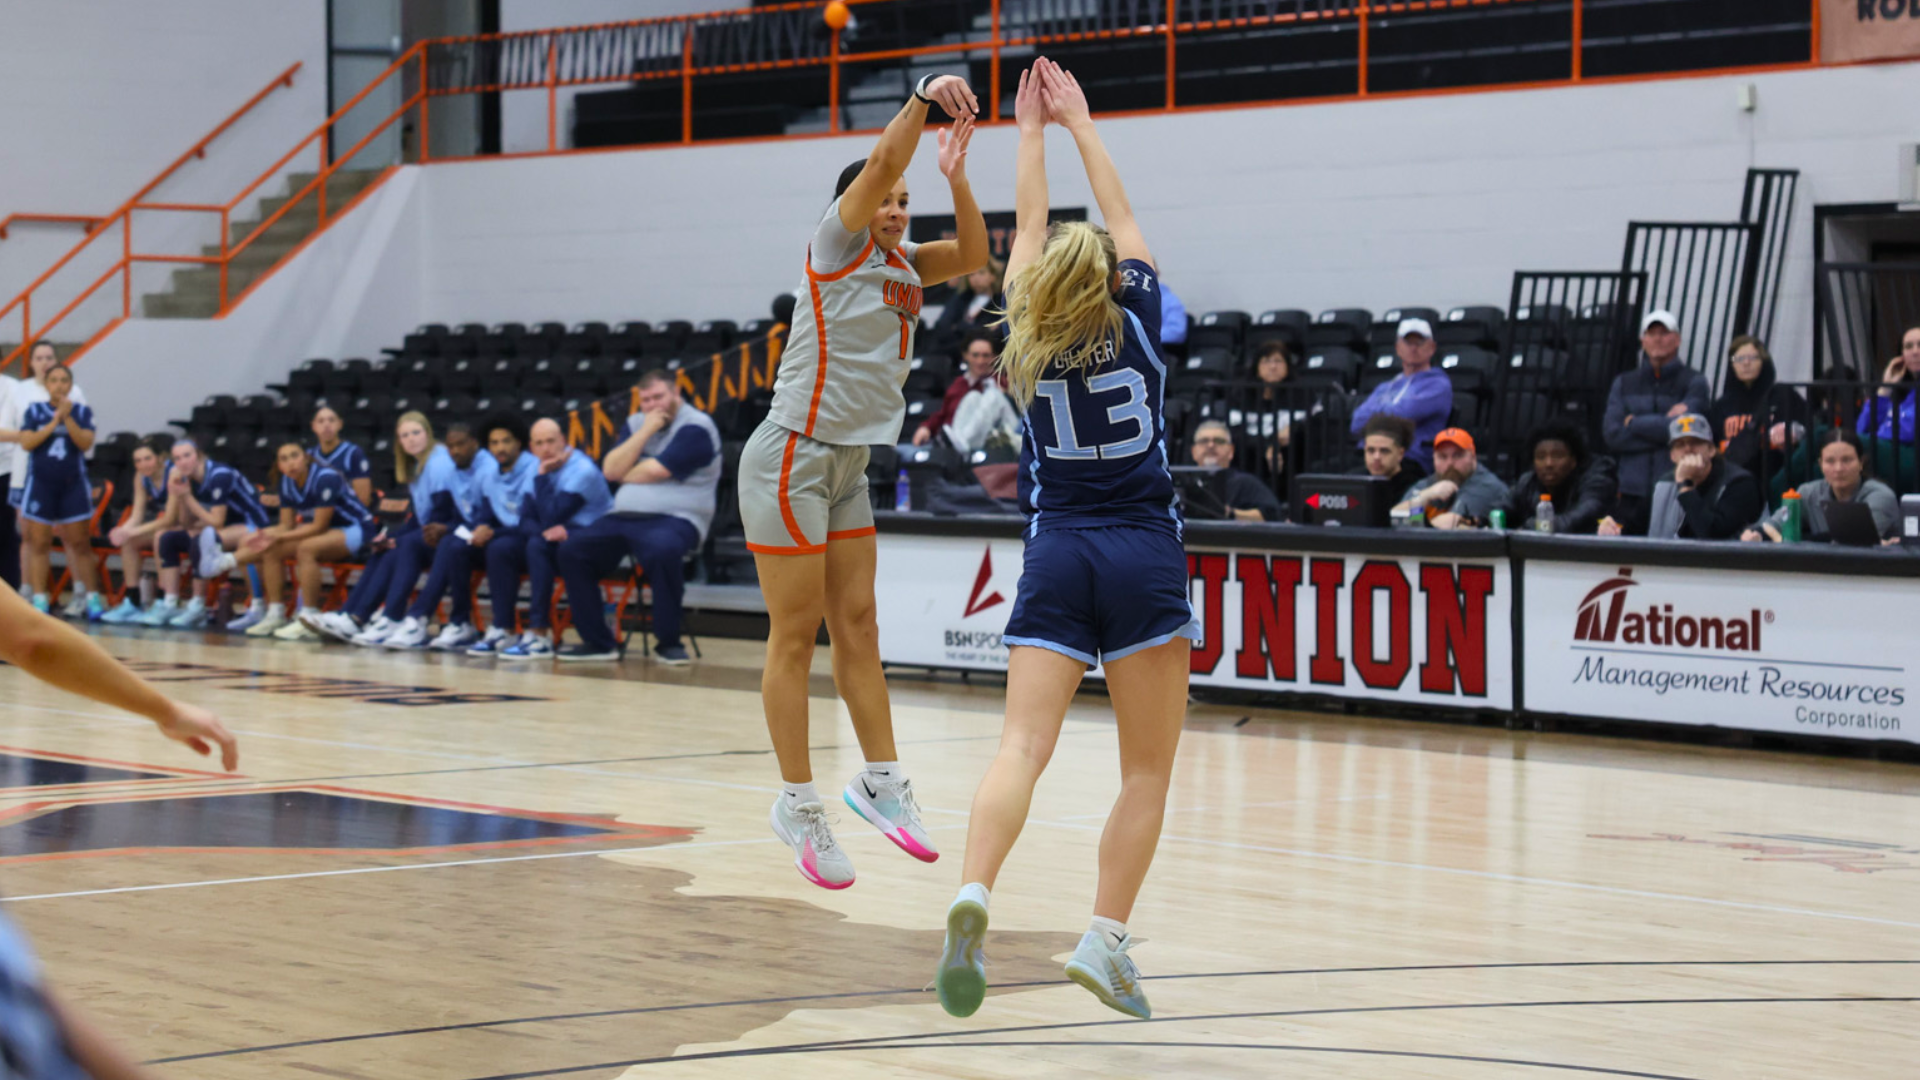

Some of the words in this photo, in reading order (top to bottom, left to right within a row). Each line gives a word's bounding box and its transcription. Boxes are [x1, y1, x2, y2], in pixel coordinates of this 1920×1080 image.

[883, 279, 923, 315] UNIO
[898, 312, 909, 360] 1
[1035, 367, 1154, 459] 13
[47, 436, 67, 461] 4
[1319, 494, 1348, 510] POSS
[945, 630, 972, 647] BSN
[1187, 551, 1495, 698] UNION
[1573, 656, 1750, 695] Management
[1758, 666, 1905, 706] Resources
[1795, 706, 1901, 731] Corporation
